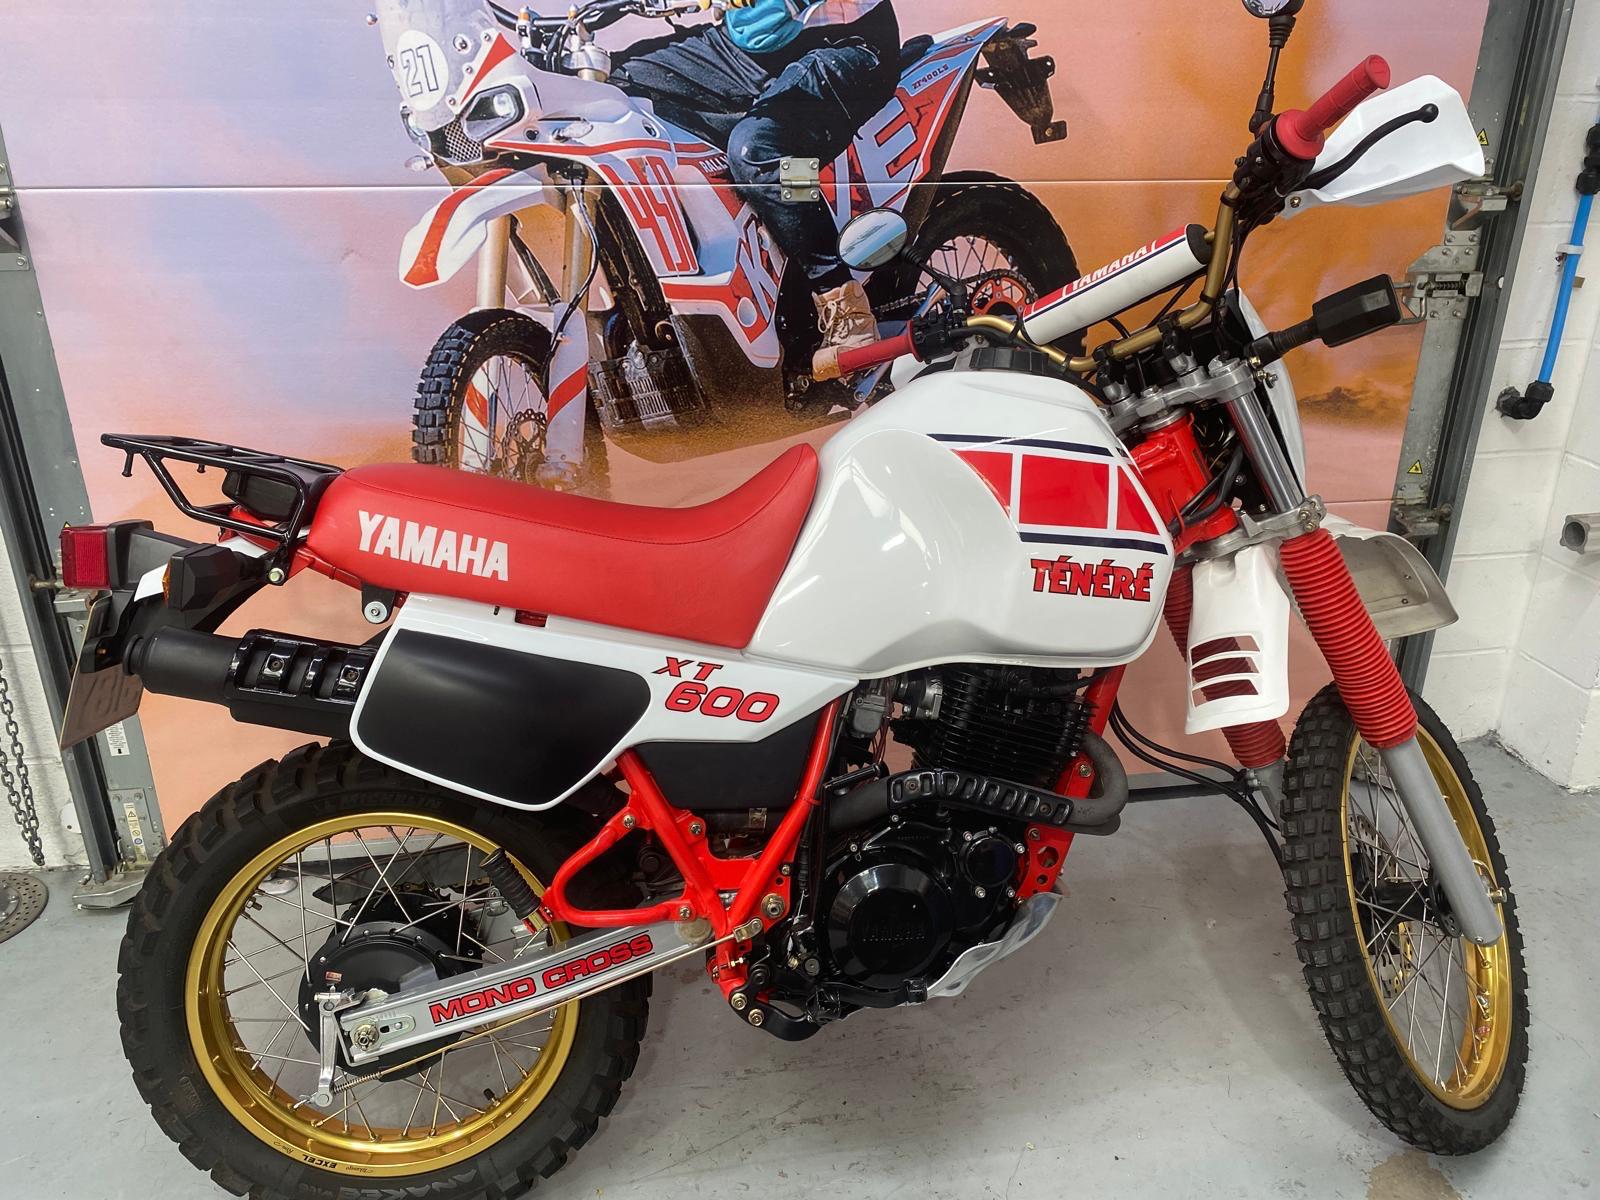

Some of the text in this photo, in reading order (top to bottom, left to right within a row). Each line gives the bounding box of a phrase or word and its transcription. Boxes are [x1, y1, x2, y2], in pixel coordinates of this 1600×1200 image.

[400, 44, 439, 97] 21
[698, 155, 729, 173] RALLY
[1071, 245, 1147, 291] YAMAHA
[358, 510, 509, 581] YAMAHA
[1030, 555, 1155, 602] TÉNÉRÉ
[651, 656, 724, 681] XT
[665, 681, 780, 723] 600
[429, 934, 654, 1024] MONO CROSS
[302, 1154, 338, 1169] EXCEL
